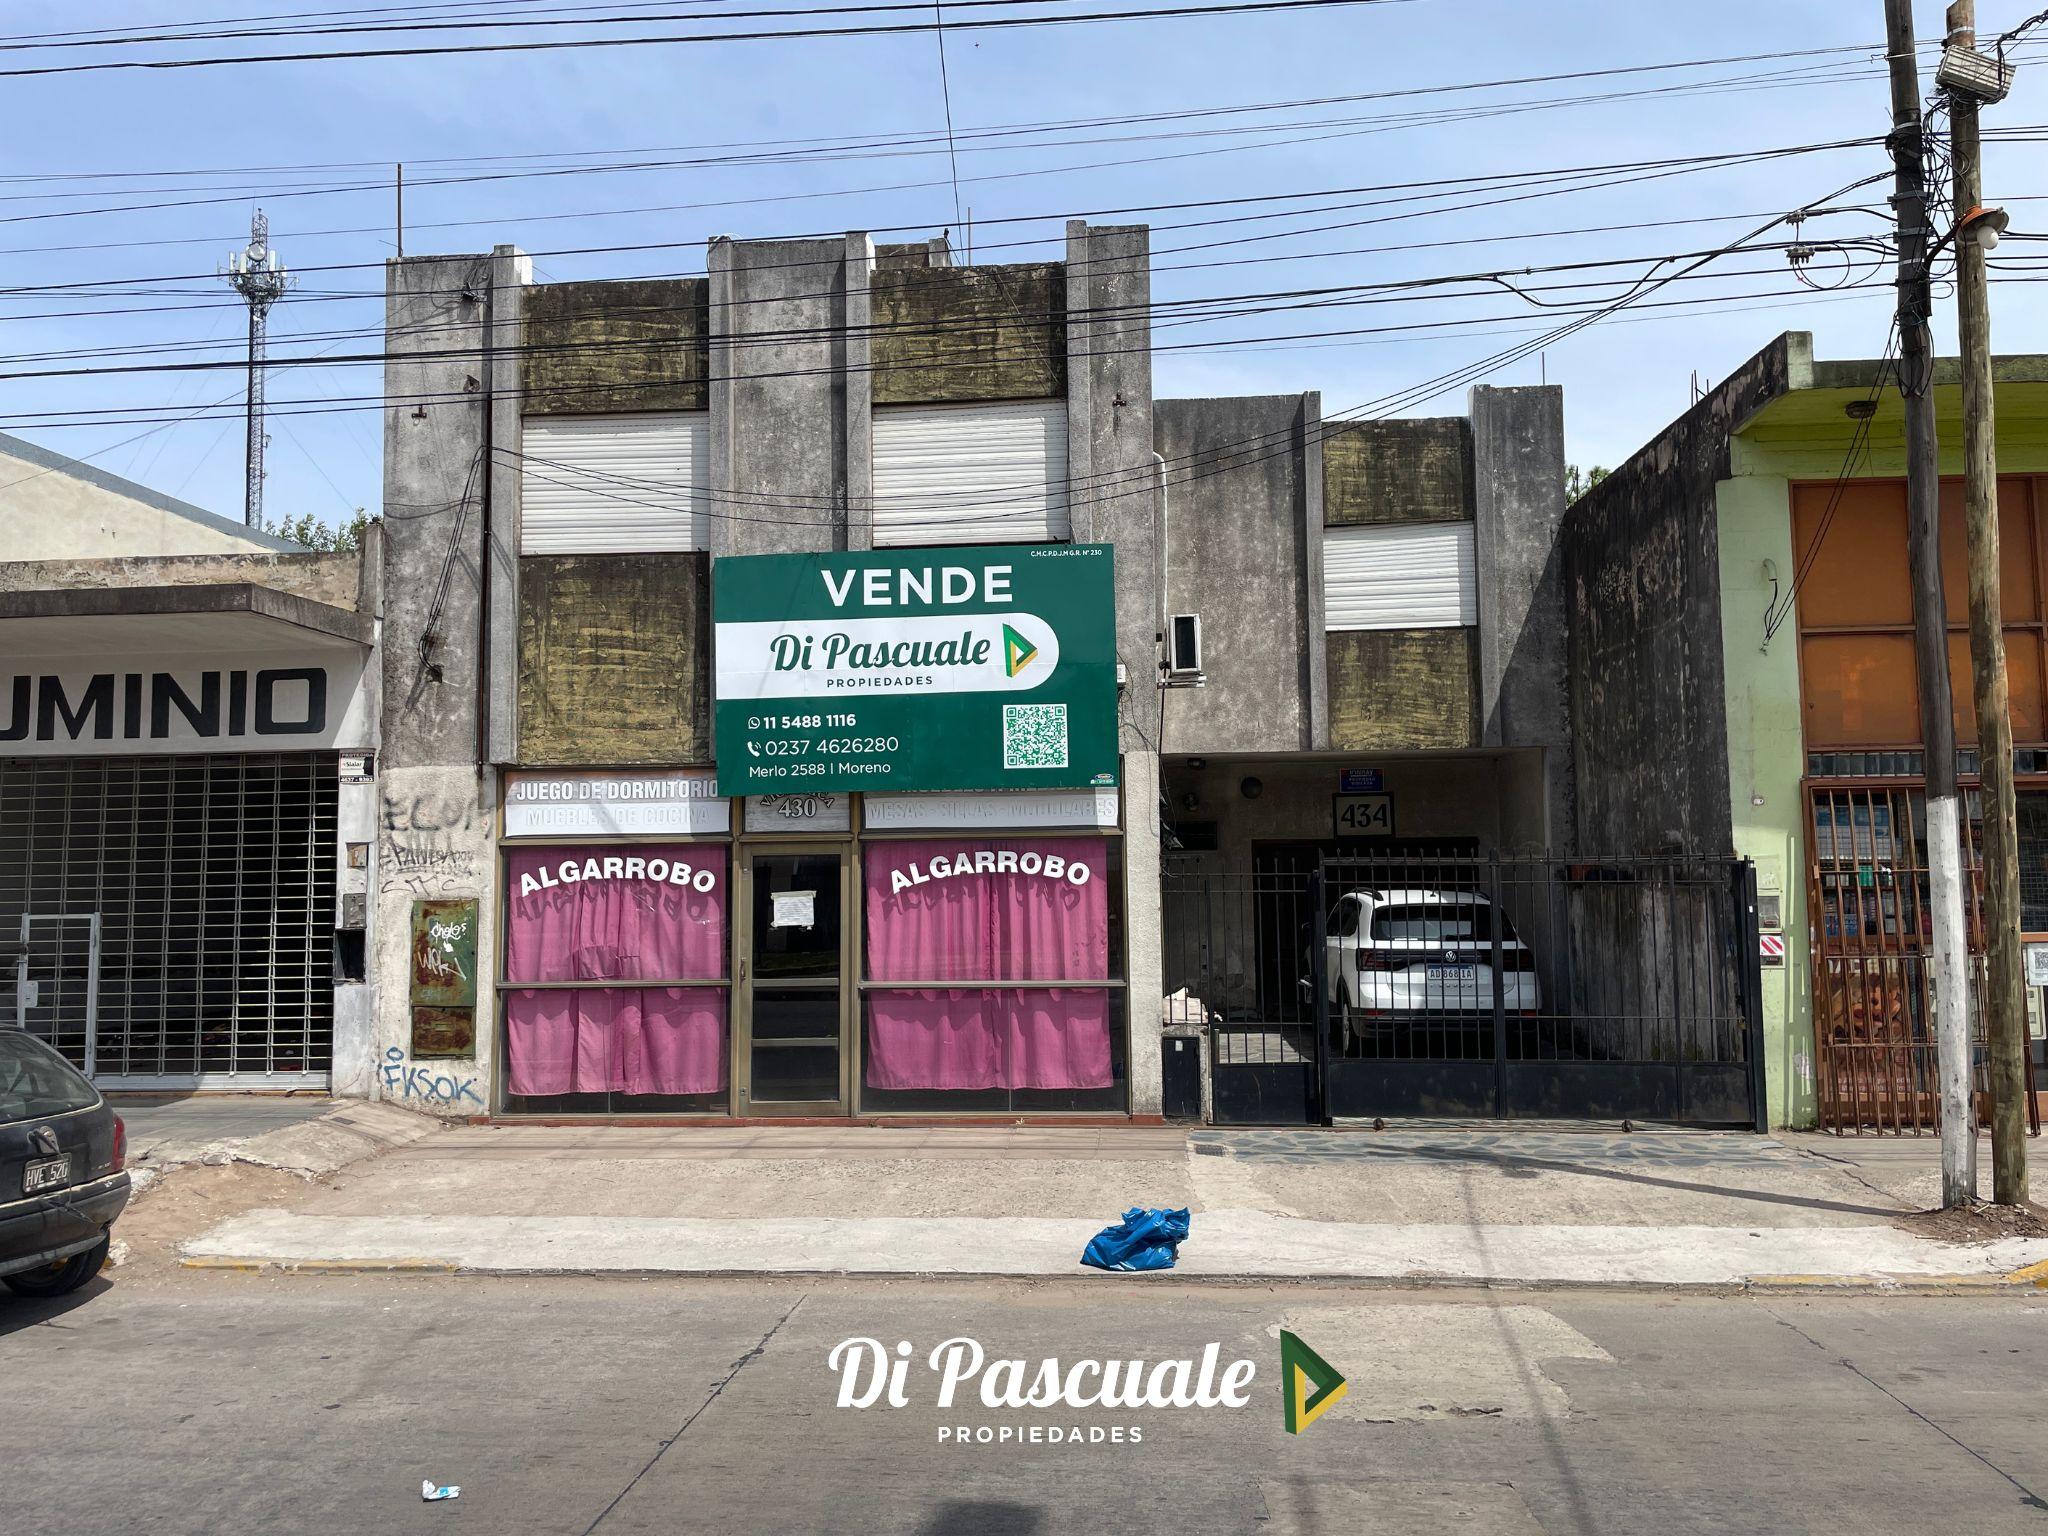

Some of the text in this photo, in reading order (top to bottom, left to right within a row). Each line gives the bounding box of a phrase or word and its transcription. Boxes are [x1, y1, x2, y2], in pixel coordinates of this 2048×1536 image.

[820, 565, 1013, 607] VENDE
[770, 630, 991, 671] Di Pascuale
[826, 675, 933, 688] PROPIEDADES
[763, 713, 856, 729] 11 5488 1116
[765, 736, 899, 756] 0237 4626280
[749, 765, 787, 778] Merlo
[791, 763, 826, 776] 2588
[838, 762, 891, 775] Moreno
[516, 781, 573, 800] JUEGO
[579, 781, 602, 799] DE
[526, 807, 712, 826] MUEBLES DE COCINA
[778, 798, 817, 818] 430
[867, 800, 927, 819] MESAS
[938, 800, 997, 819] SILLAS
[1341, 803, 1388, 828] 434
[520, 856, 716, 897] ALGARROBO
[890, 850, 1090, 894] ALGARROBO
[1430, 969, 1441, 978] AD
[26, 1162, 68, 1187] HVE 520
